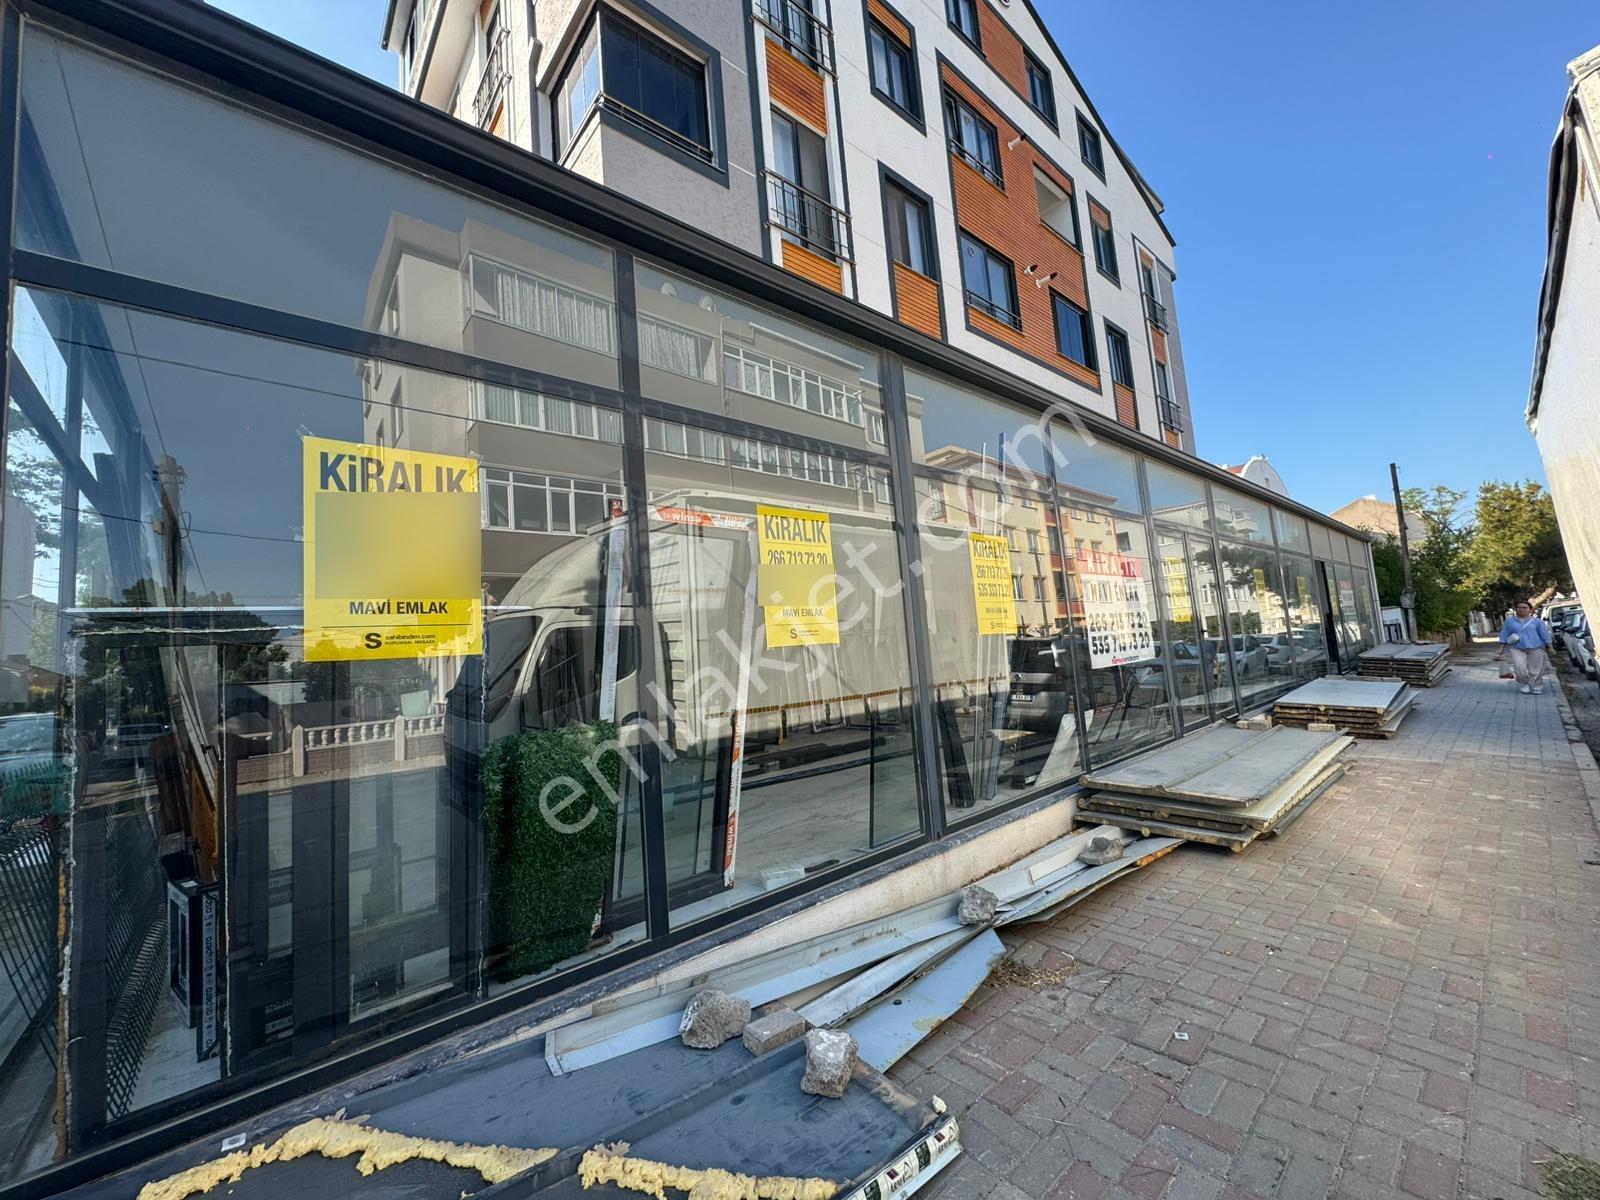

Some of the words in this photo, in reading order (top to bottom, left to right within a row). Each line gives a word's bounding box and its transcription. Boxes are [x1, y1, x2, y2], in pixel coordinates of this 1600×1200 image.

[672, 512, 702, 523] winsa
[768, 549, 785, 565] 266
[349, 599, 391, 615] MAVİ
[396, 601, 448, 614] EMLAK
[801, 608, 824, 618] EMLAK
[1092, 635, 1110, 655] 535
[1140, 631, 1150, 648] 20
[727, 825, 735, 856] winsa
